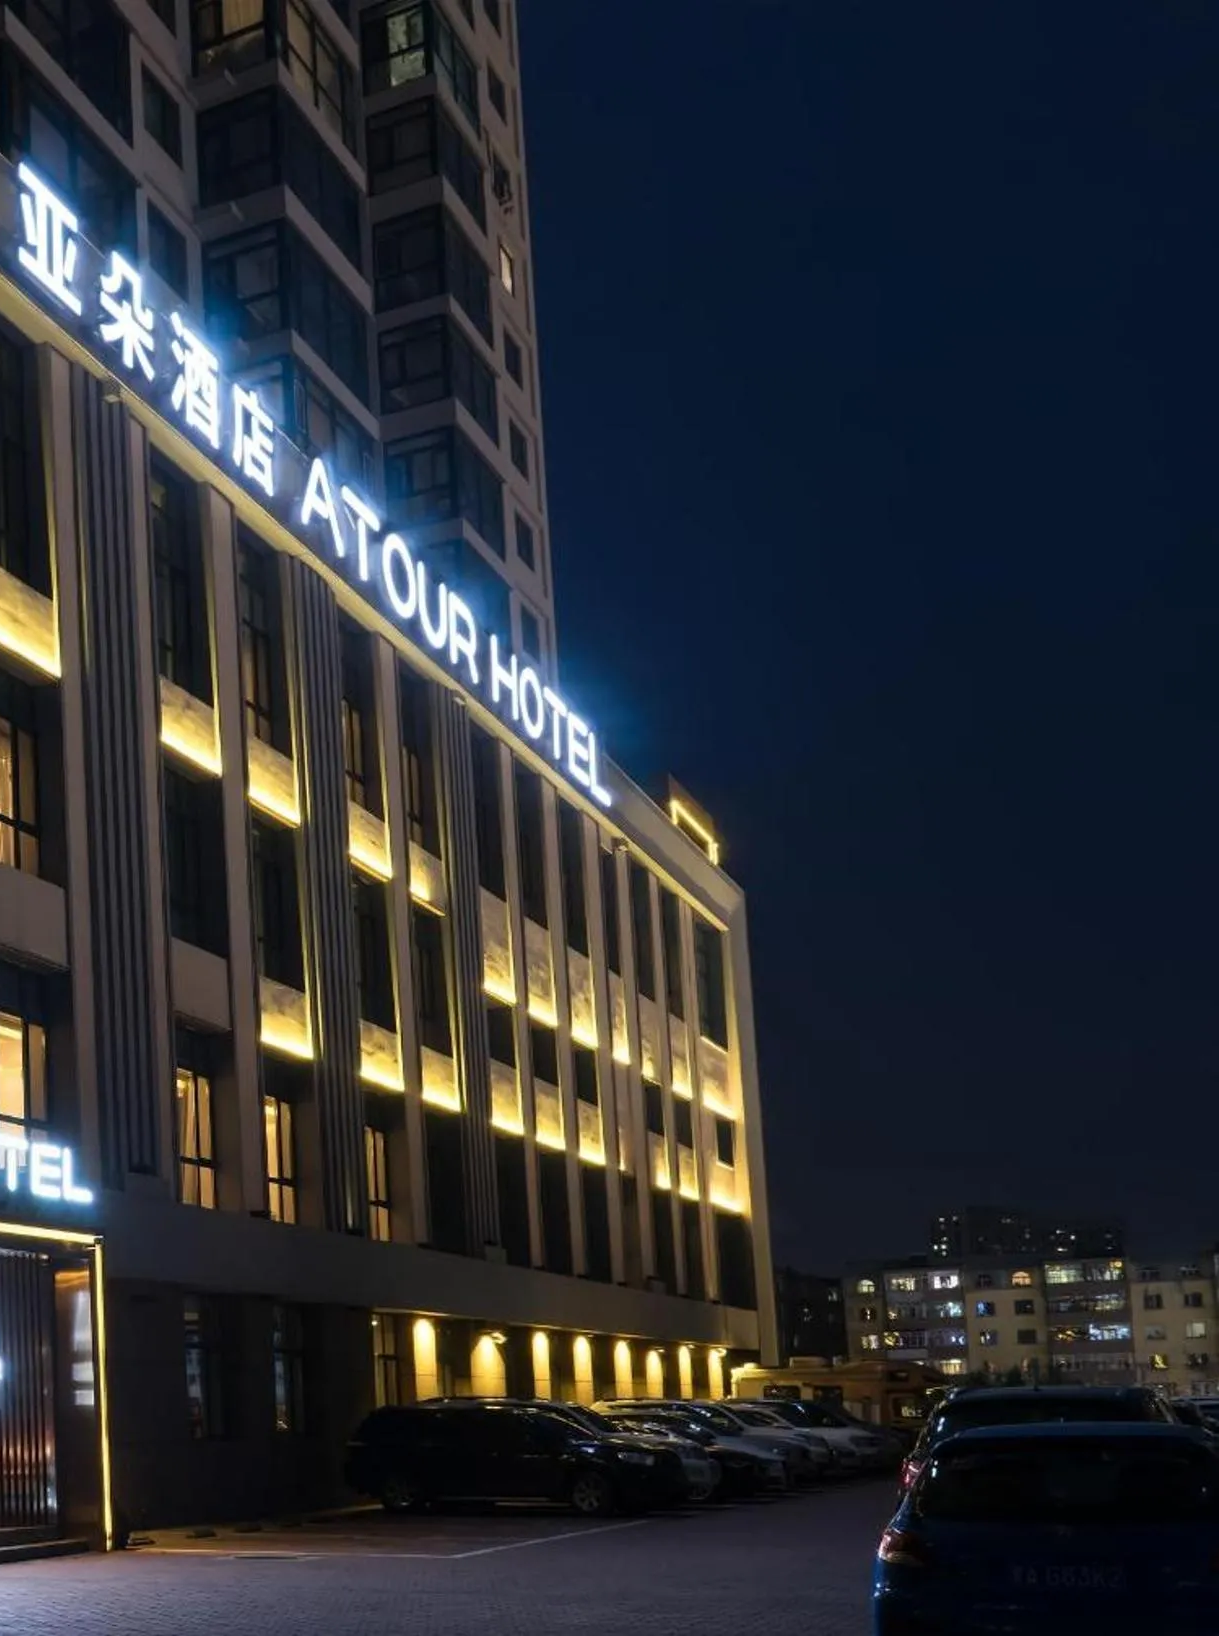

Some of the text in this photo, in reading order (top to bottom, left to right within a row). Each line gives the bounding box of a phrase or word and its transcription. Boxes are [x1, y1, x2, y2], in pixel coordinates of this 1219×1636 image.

[18, 162, 612, 806] 亚朵酒店 ATOUR HOTEL
